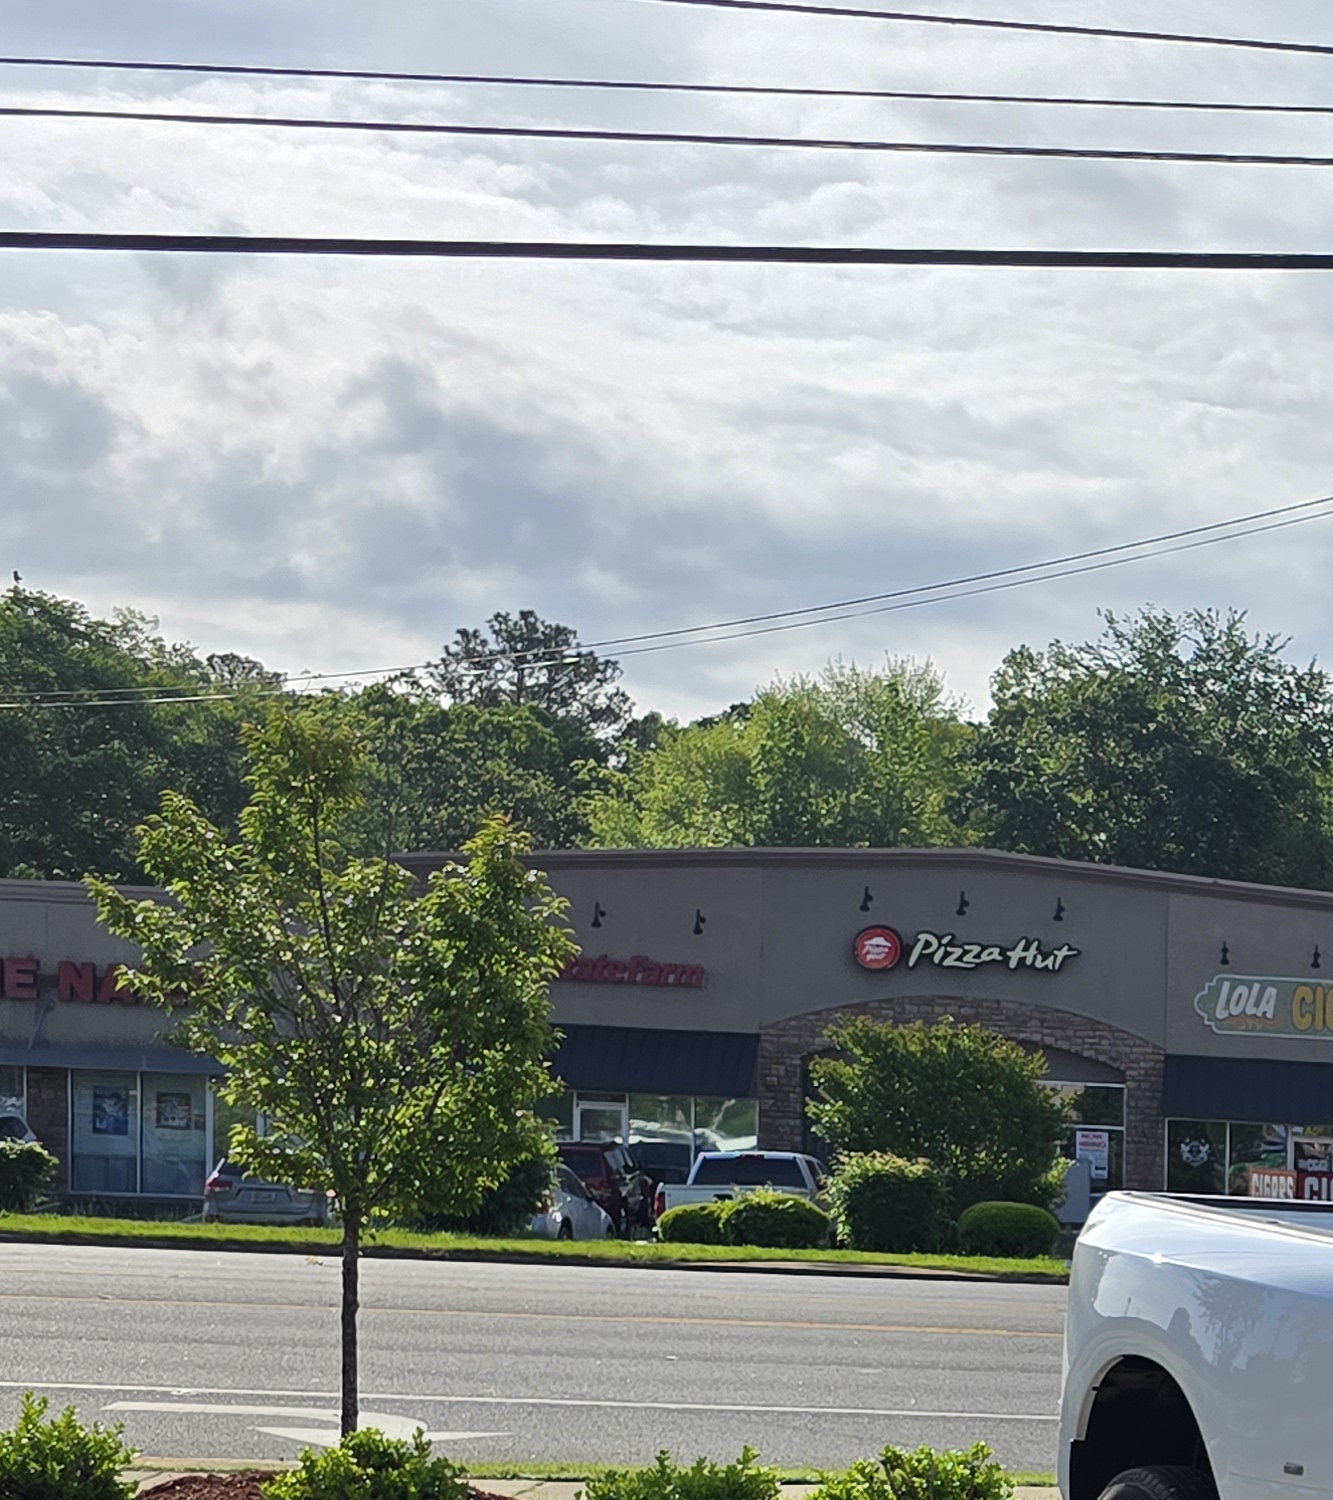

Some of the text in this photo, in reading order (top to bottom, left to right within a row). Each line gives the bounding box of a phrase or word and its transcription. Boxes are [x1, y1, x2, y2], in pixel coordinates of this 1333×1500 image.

[908, 933, 1078, 971] Pizza Hut
[556, 953, 704, 988] tateFarm
[1215, 981, 1278, 1020] LOLA
[1251, 1173, 1295, 1200] CIGARS
